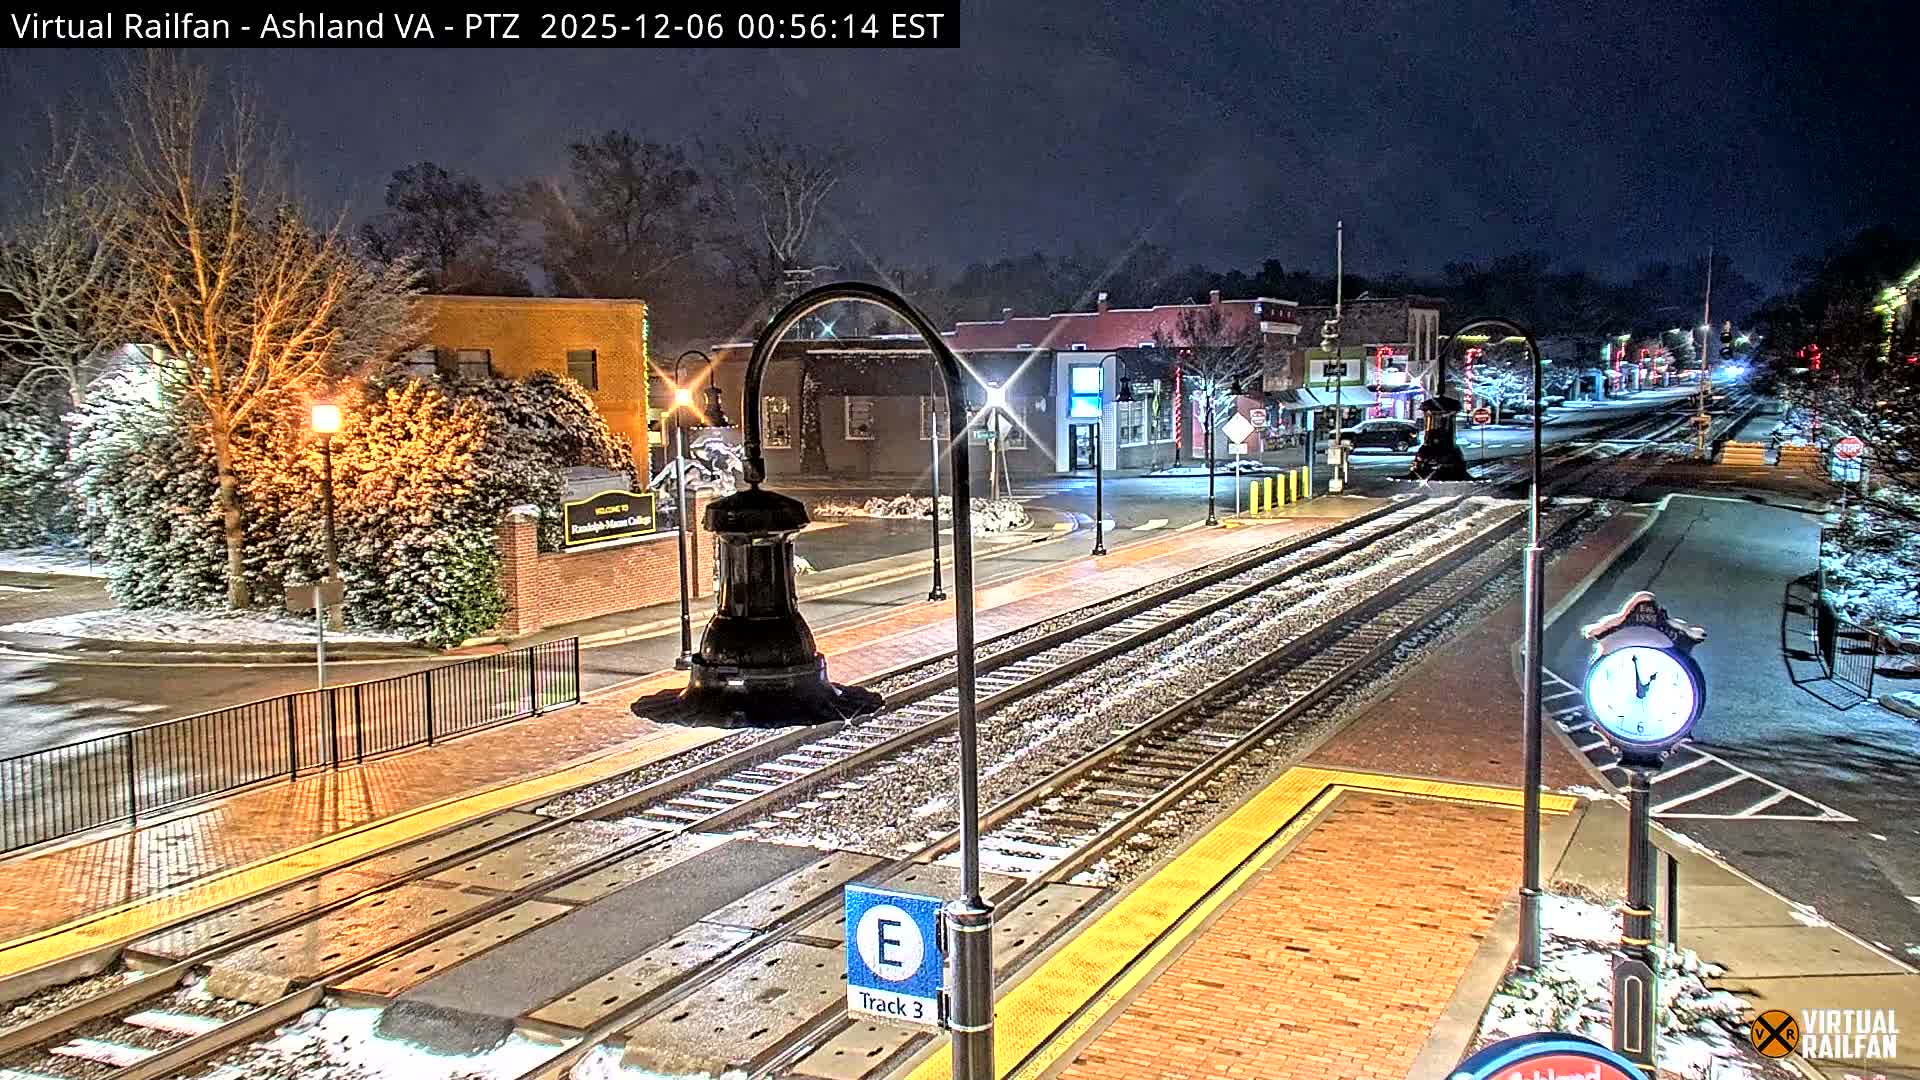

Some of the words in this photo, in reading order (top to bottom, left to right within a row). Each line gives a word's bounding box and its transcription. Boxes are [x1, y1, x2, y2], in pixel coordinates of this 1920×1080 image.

[1838, 443, 1861, 453] STOP
[877, 918, 903, 968] E
[859, 992, 907, 1017] Track
[912, 1000, 924, 1019] 3
[1508, 1064, 1602, 1080] Ahld
